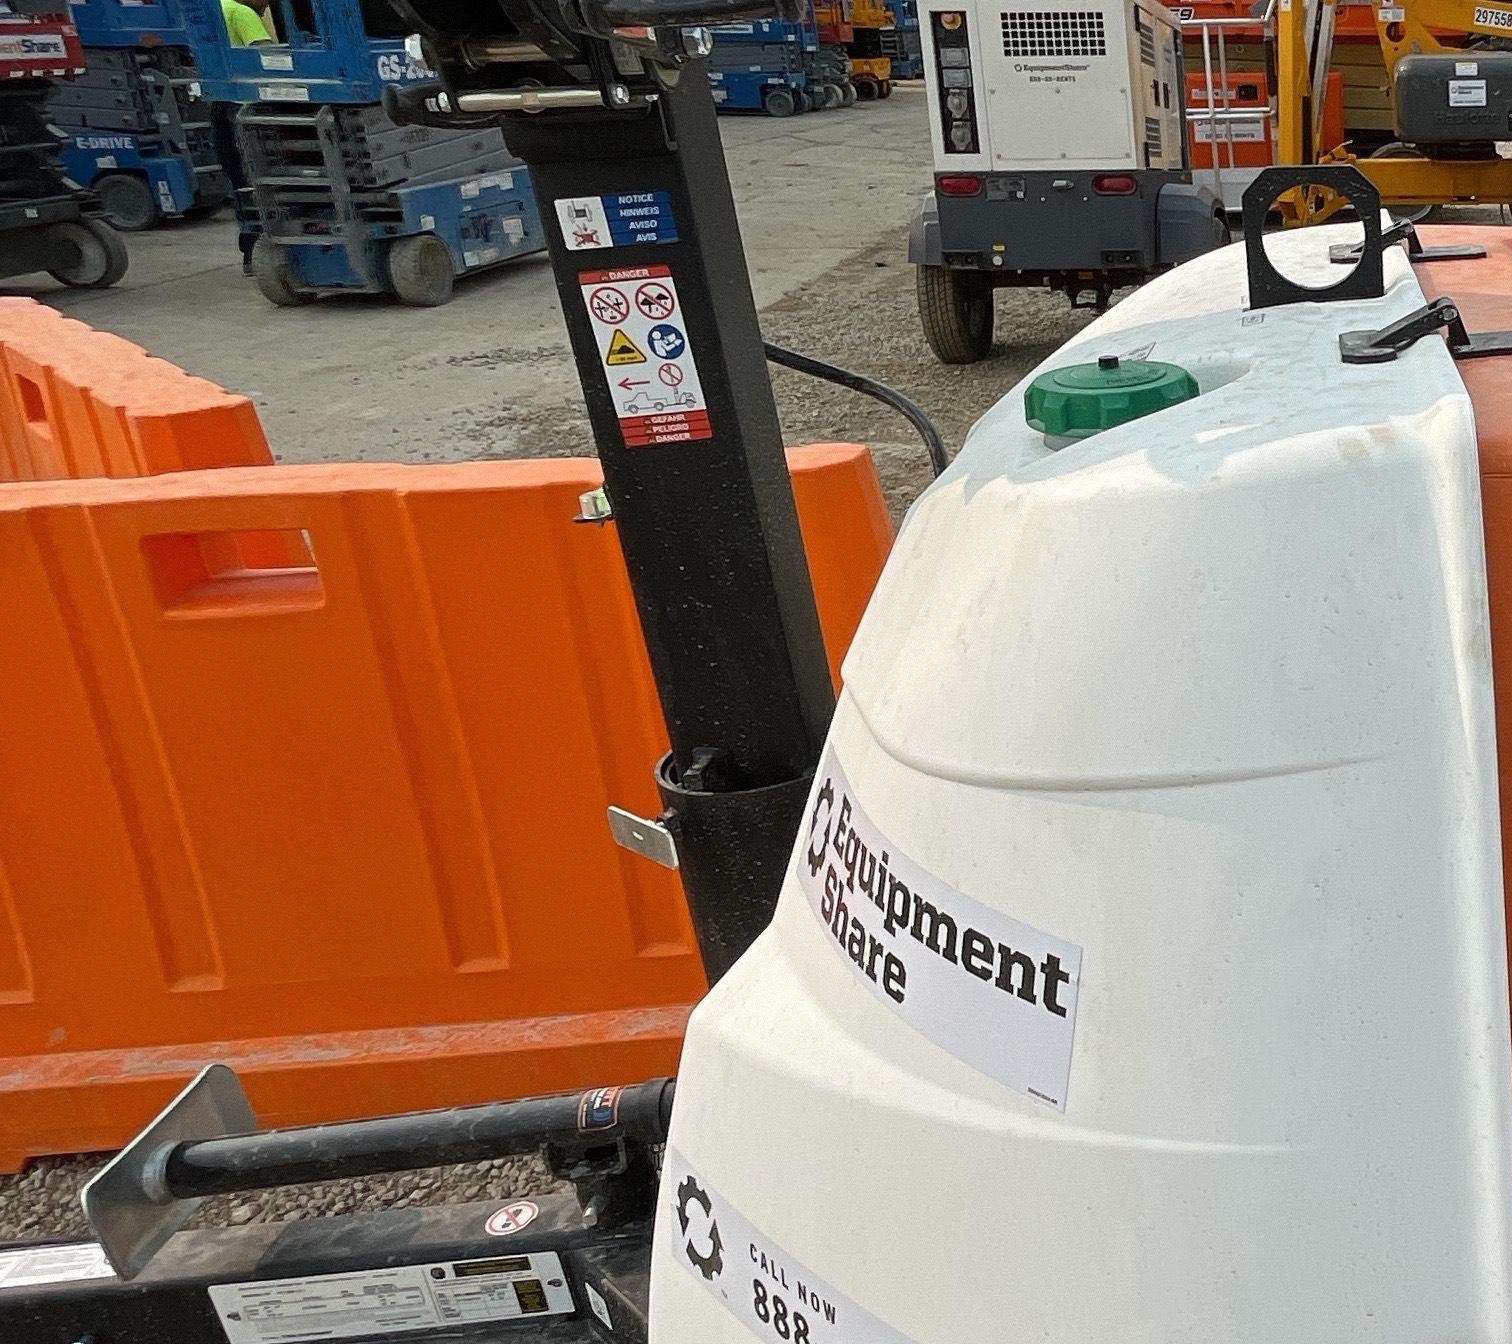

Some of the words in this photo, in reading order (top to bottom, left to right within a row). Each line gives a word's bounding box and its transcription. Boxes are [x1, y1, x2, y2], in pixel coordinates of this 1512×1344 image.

[75, 136, 135, 150] E-DRIVE
[618, 193, 654, 204] NOTICE
[619, 206, 660, 217] HINWEIS
[629, 219, 658, 230] AVISO
[636, 232, 657, 242] AVIS
[608, 268, 650, 281] DANGER
[655, 432, 692, 443] DANGER
[832, 794, 1071, 1018] Equipment
[820, 862, 907, 1004] Share
[748, 1242, 789, 1291] CALL
[797, 1280, 838, 1325] NOW
